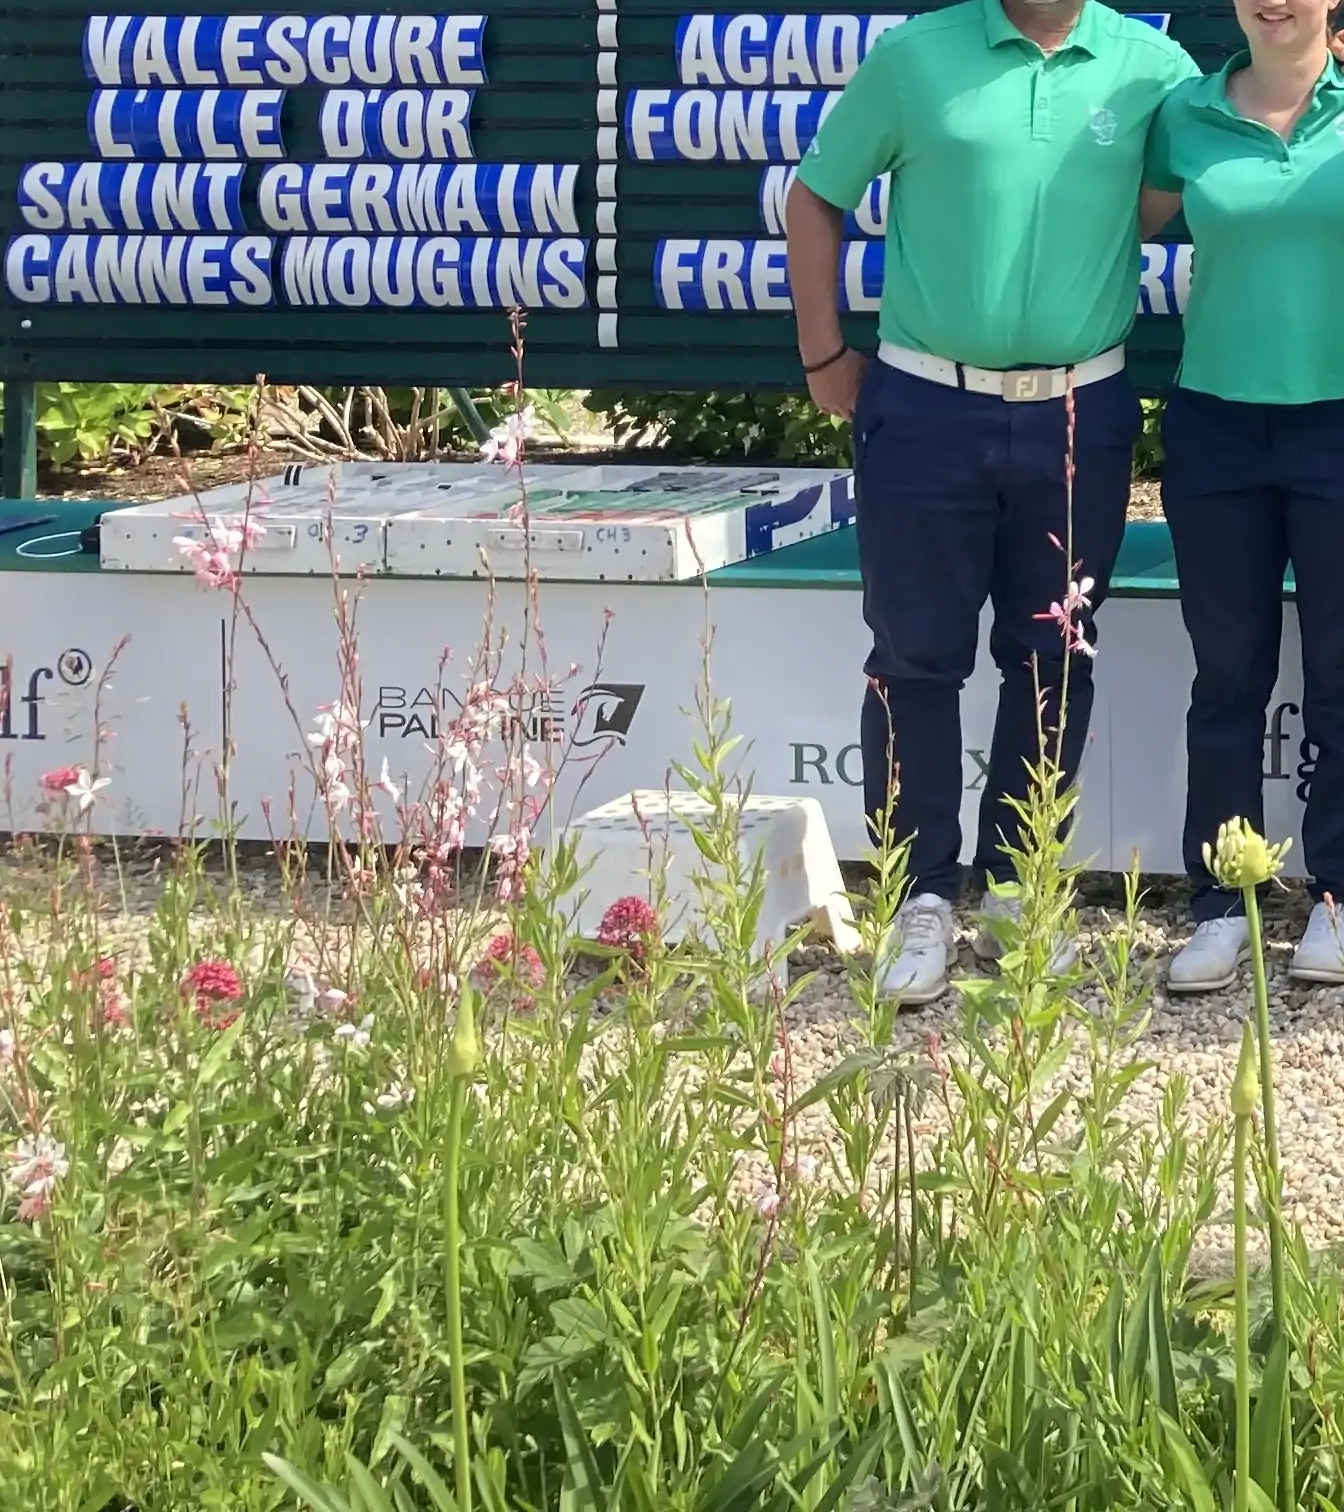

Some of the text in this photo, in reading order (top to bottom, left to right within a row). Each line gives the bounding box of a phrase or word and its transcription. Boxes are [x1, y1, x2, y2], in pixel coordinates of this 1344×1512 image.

[86, 15, 487, 84] VALESCURE
[93, 89, 474, 157] L'ILE D'OR
[20, 163, 580, 233] SAINT GERMAIN
[5, 234, 587, 307] CANNES MOUGINS
